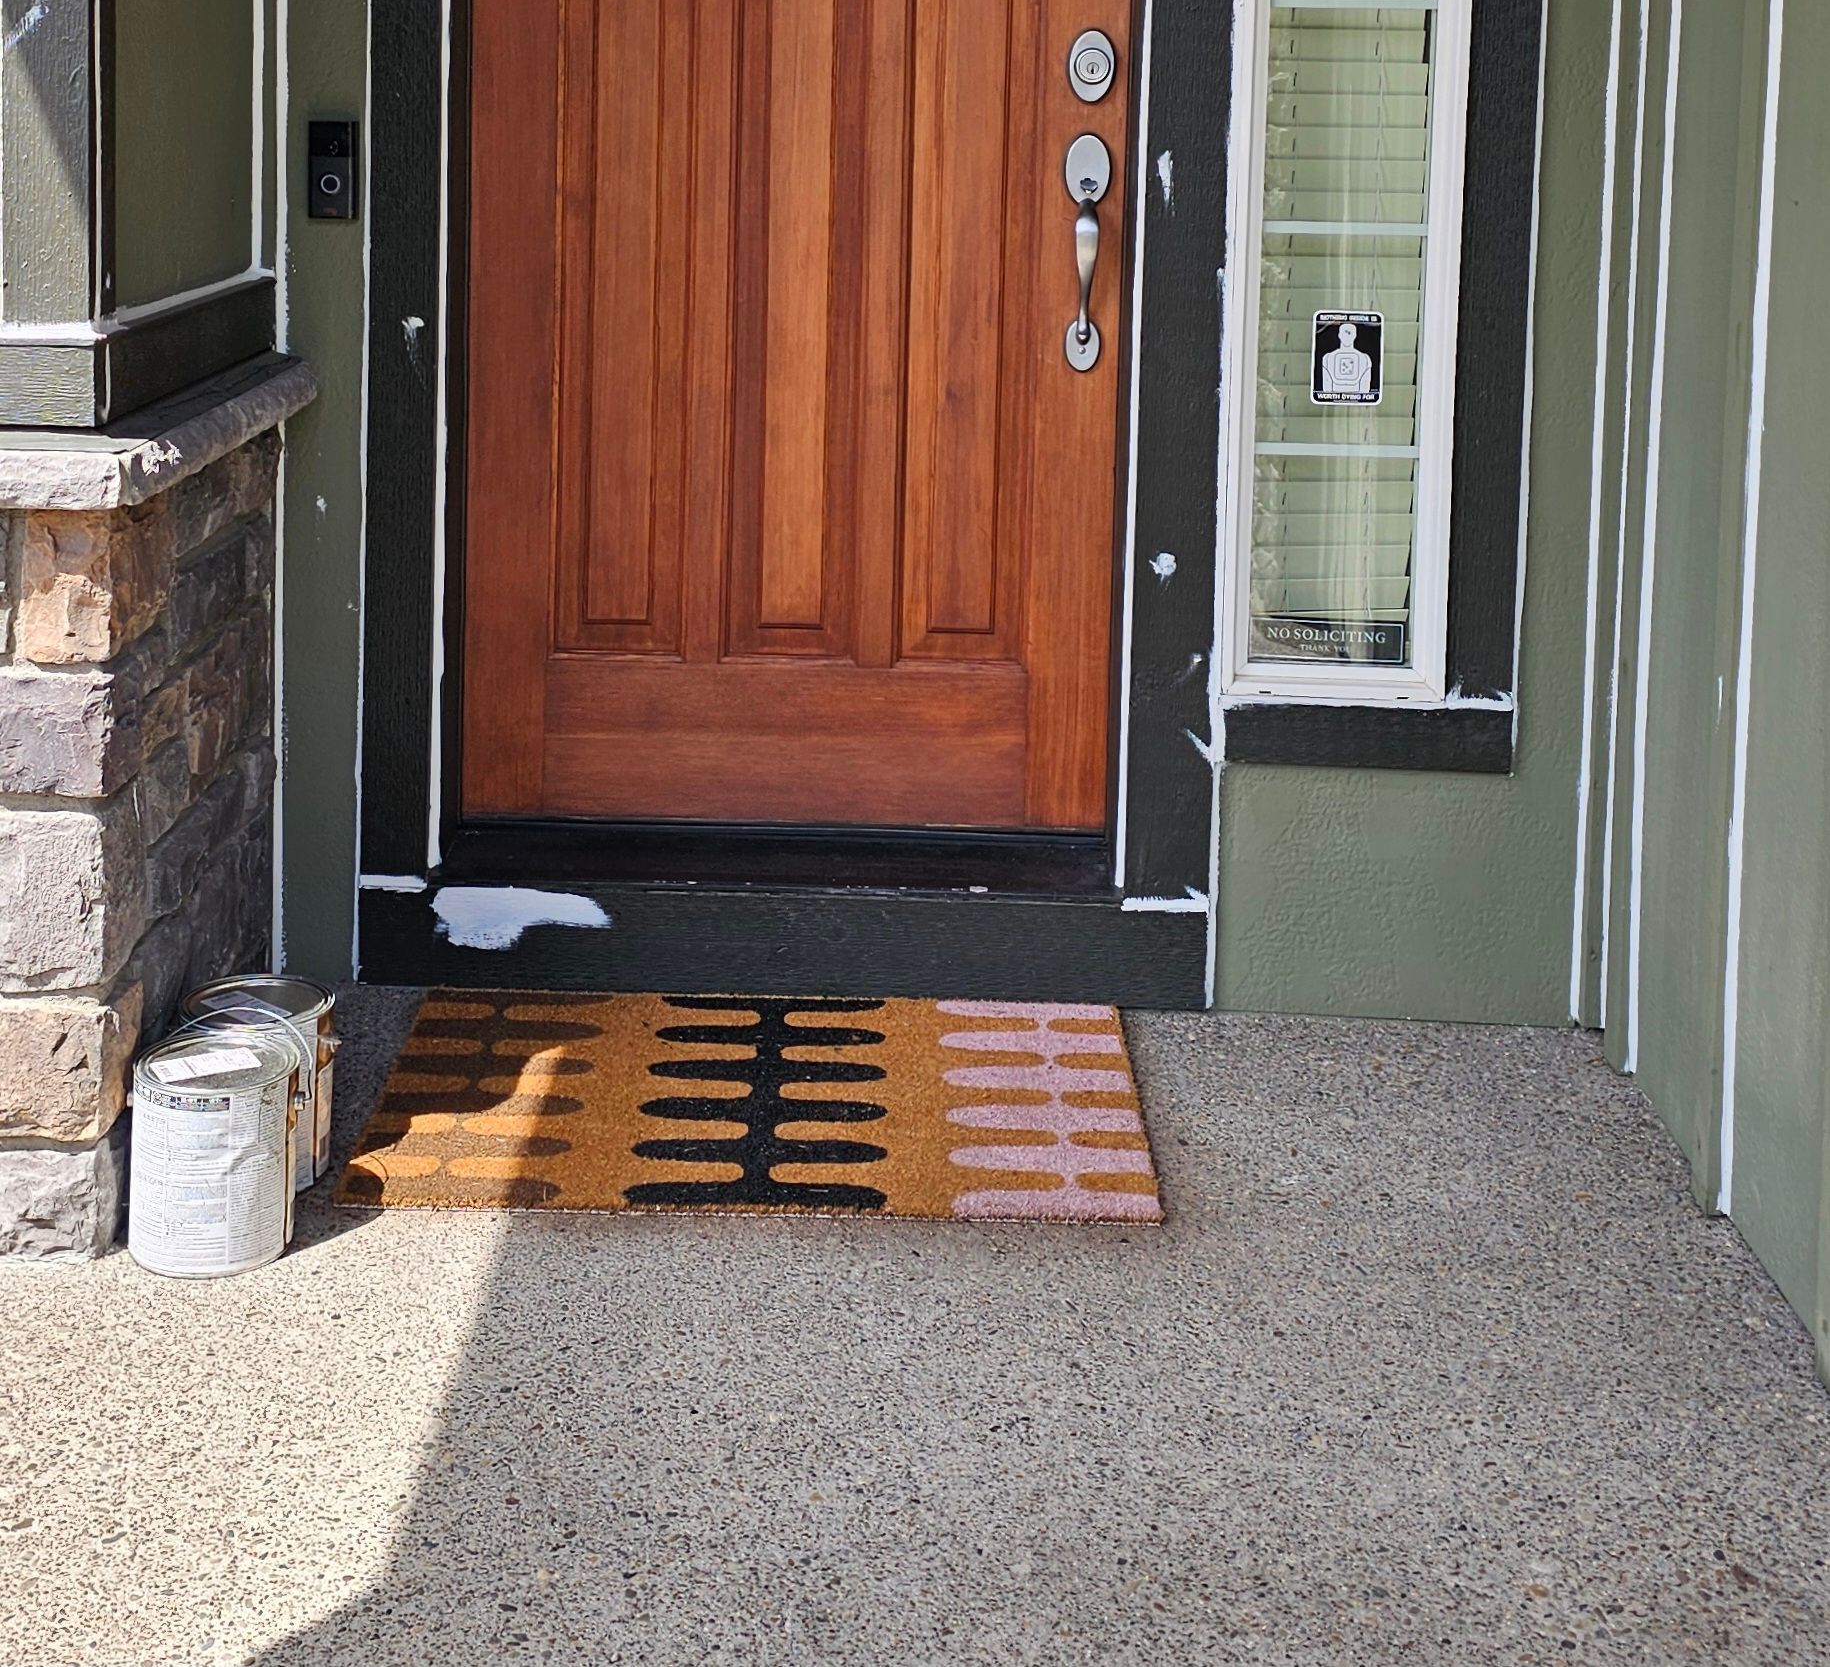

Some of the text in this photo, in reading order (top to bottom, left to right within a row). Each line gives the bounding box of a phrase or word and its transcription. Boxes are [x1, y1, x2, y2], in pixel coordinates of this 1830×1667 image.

[1267, 626, 1386, 644] NO SOLICITING
[1300, 643, 1330, 653] THANK
